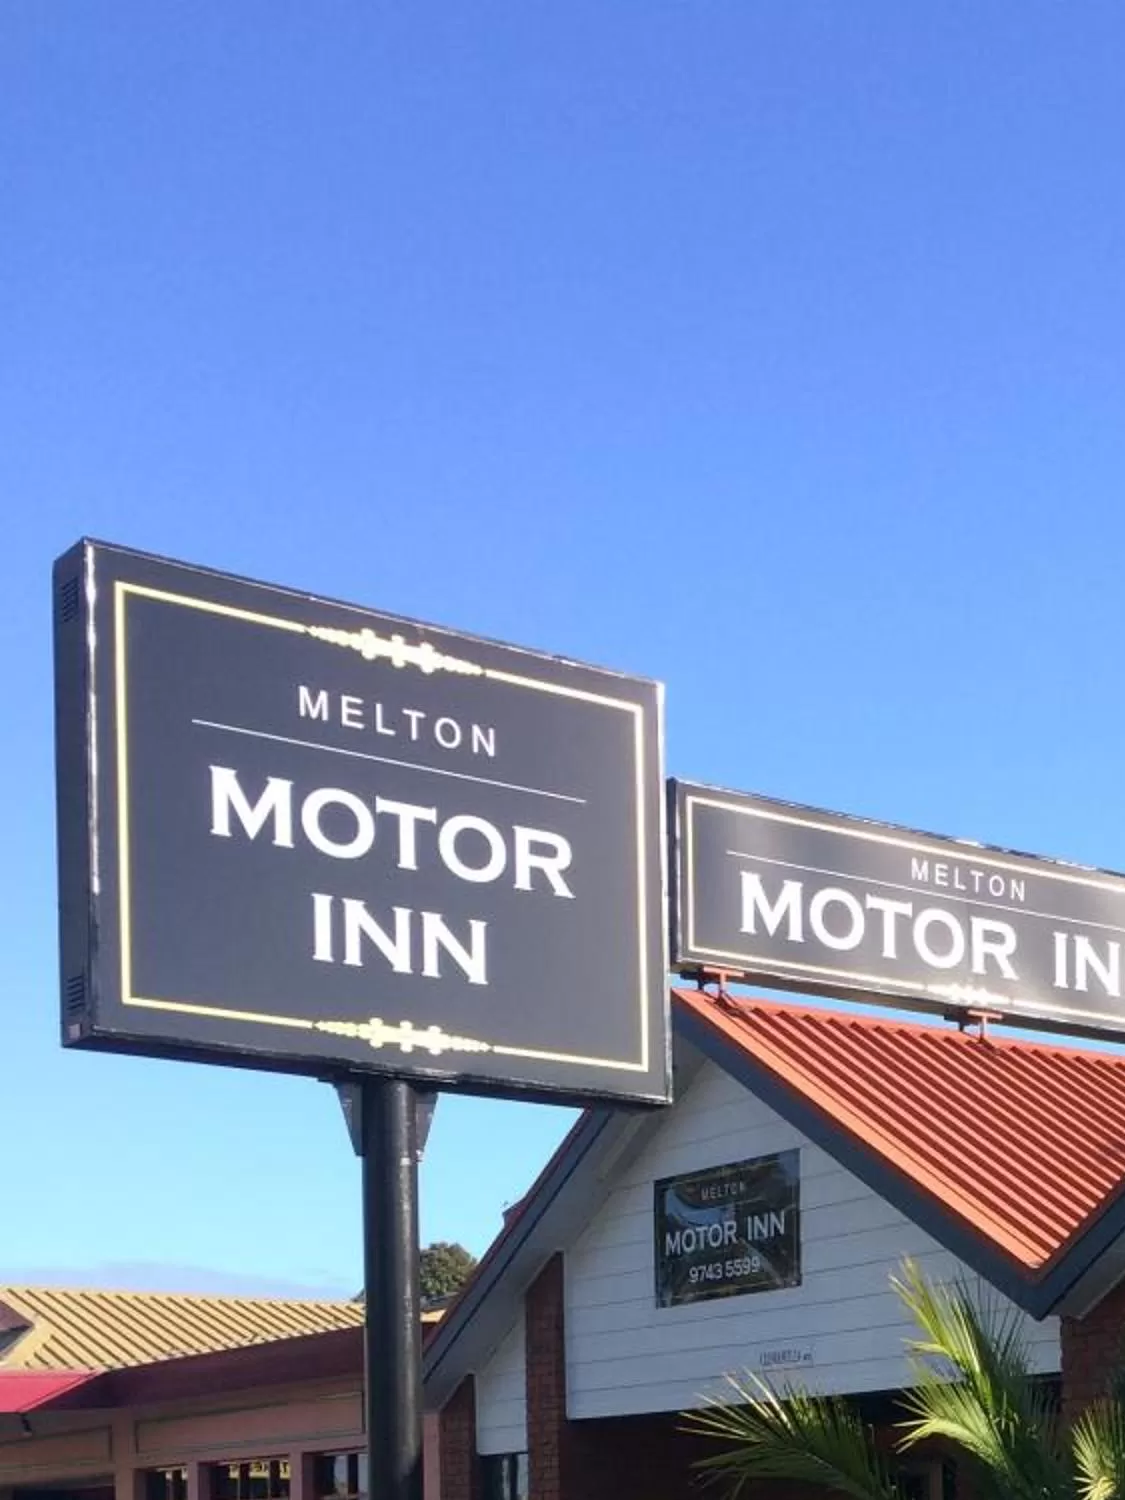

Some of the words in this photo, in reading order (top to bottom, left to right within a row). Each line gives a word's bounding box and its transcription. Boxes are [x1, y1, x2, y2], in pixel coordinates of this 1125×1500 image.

[299, 686, 496, 757] MELTON
[209, 765, 576, 899] MOTOR
[910, 857, 1027, 902] MELTON
[312, 893, 487, 985] INN
[739, 871, 1020, 980] MOTOR
[665, 1220, 738, 1256] MOTOR
[747, 1210, 786, 1241] INN
[688, 1263, 723, 1283] 9743
